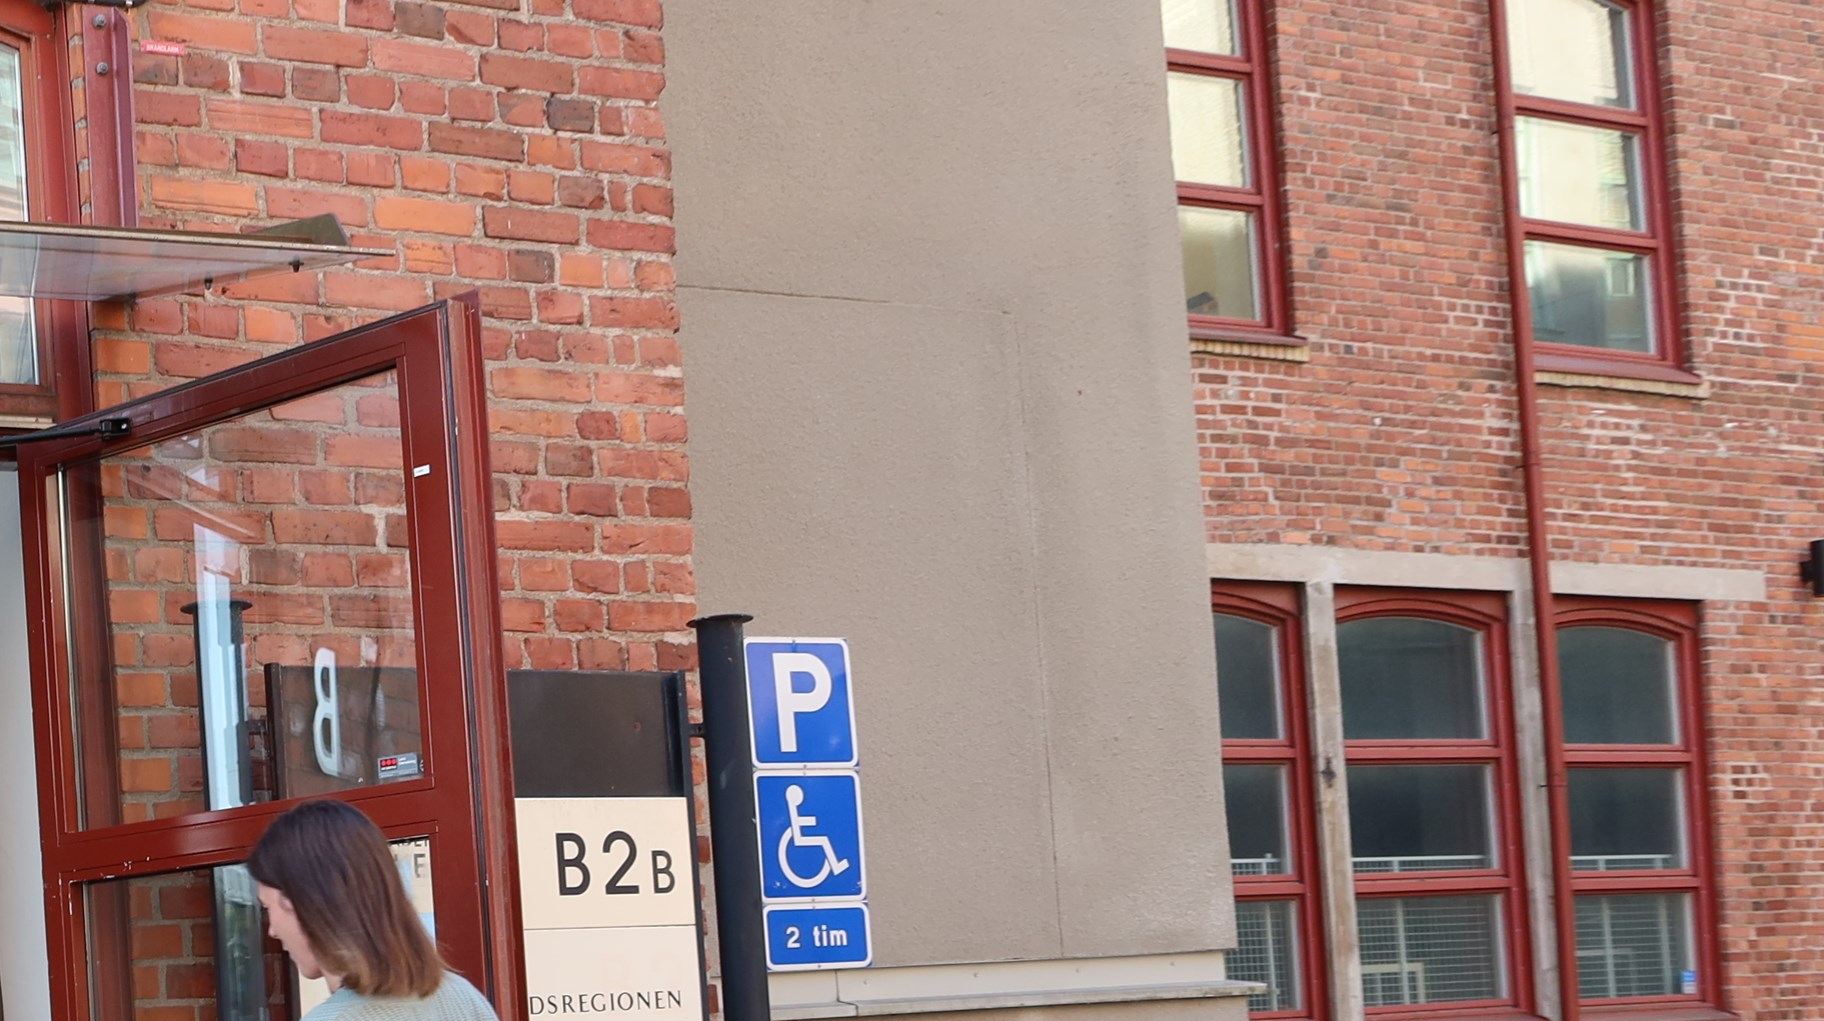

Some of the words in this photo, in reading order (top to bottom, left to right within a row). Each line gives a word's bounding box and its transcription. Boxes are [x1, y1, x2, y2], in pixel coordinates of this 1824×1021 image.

[772, 652, 832, 752] P
[785, 926, 801, 949] 2
[812, 924, 848, 948] tim
[529, 990, 682, 1015] DSREGIONEN
